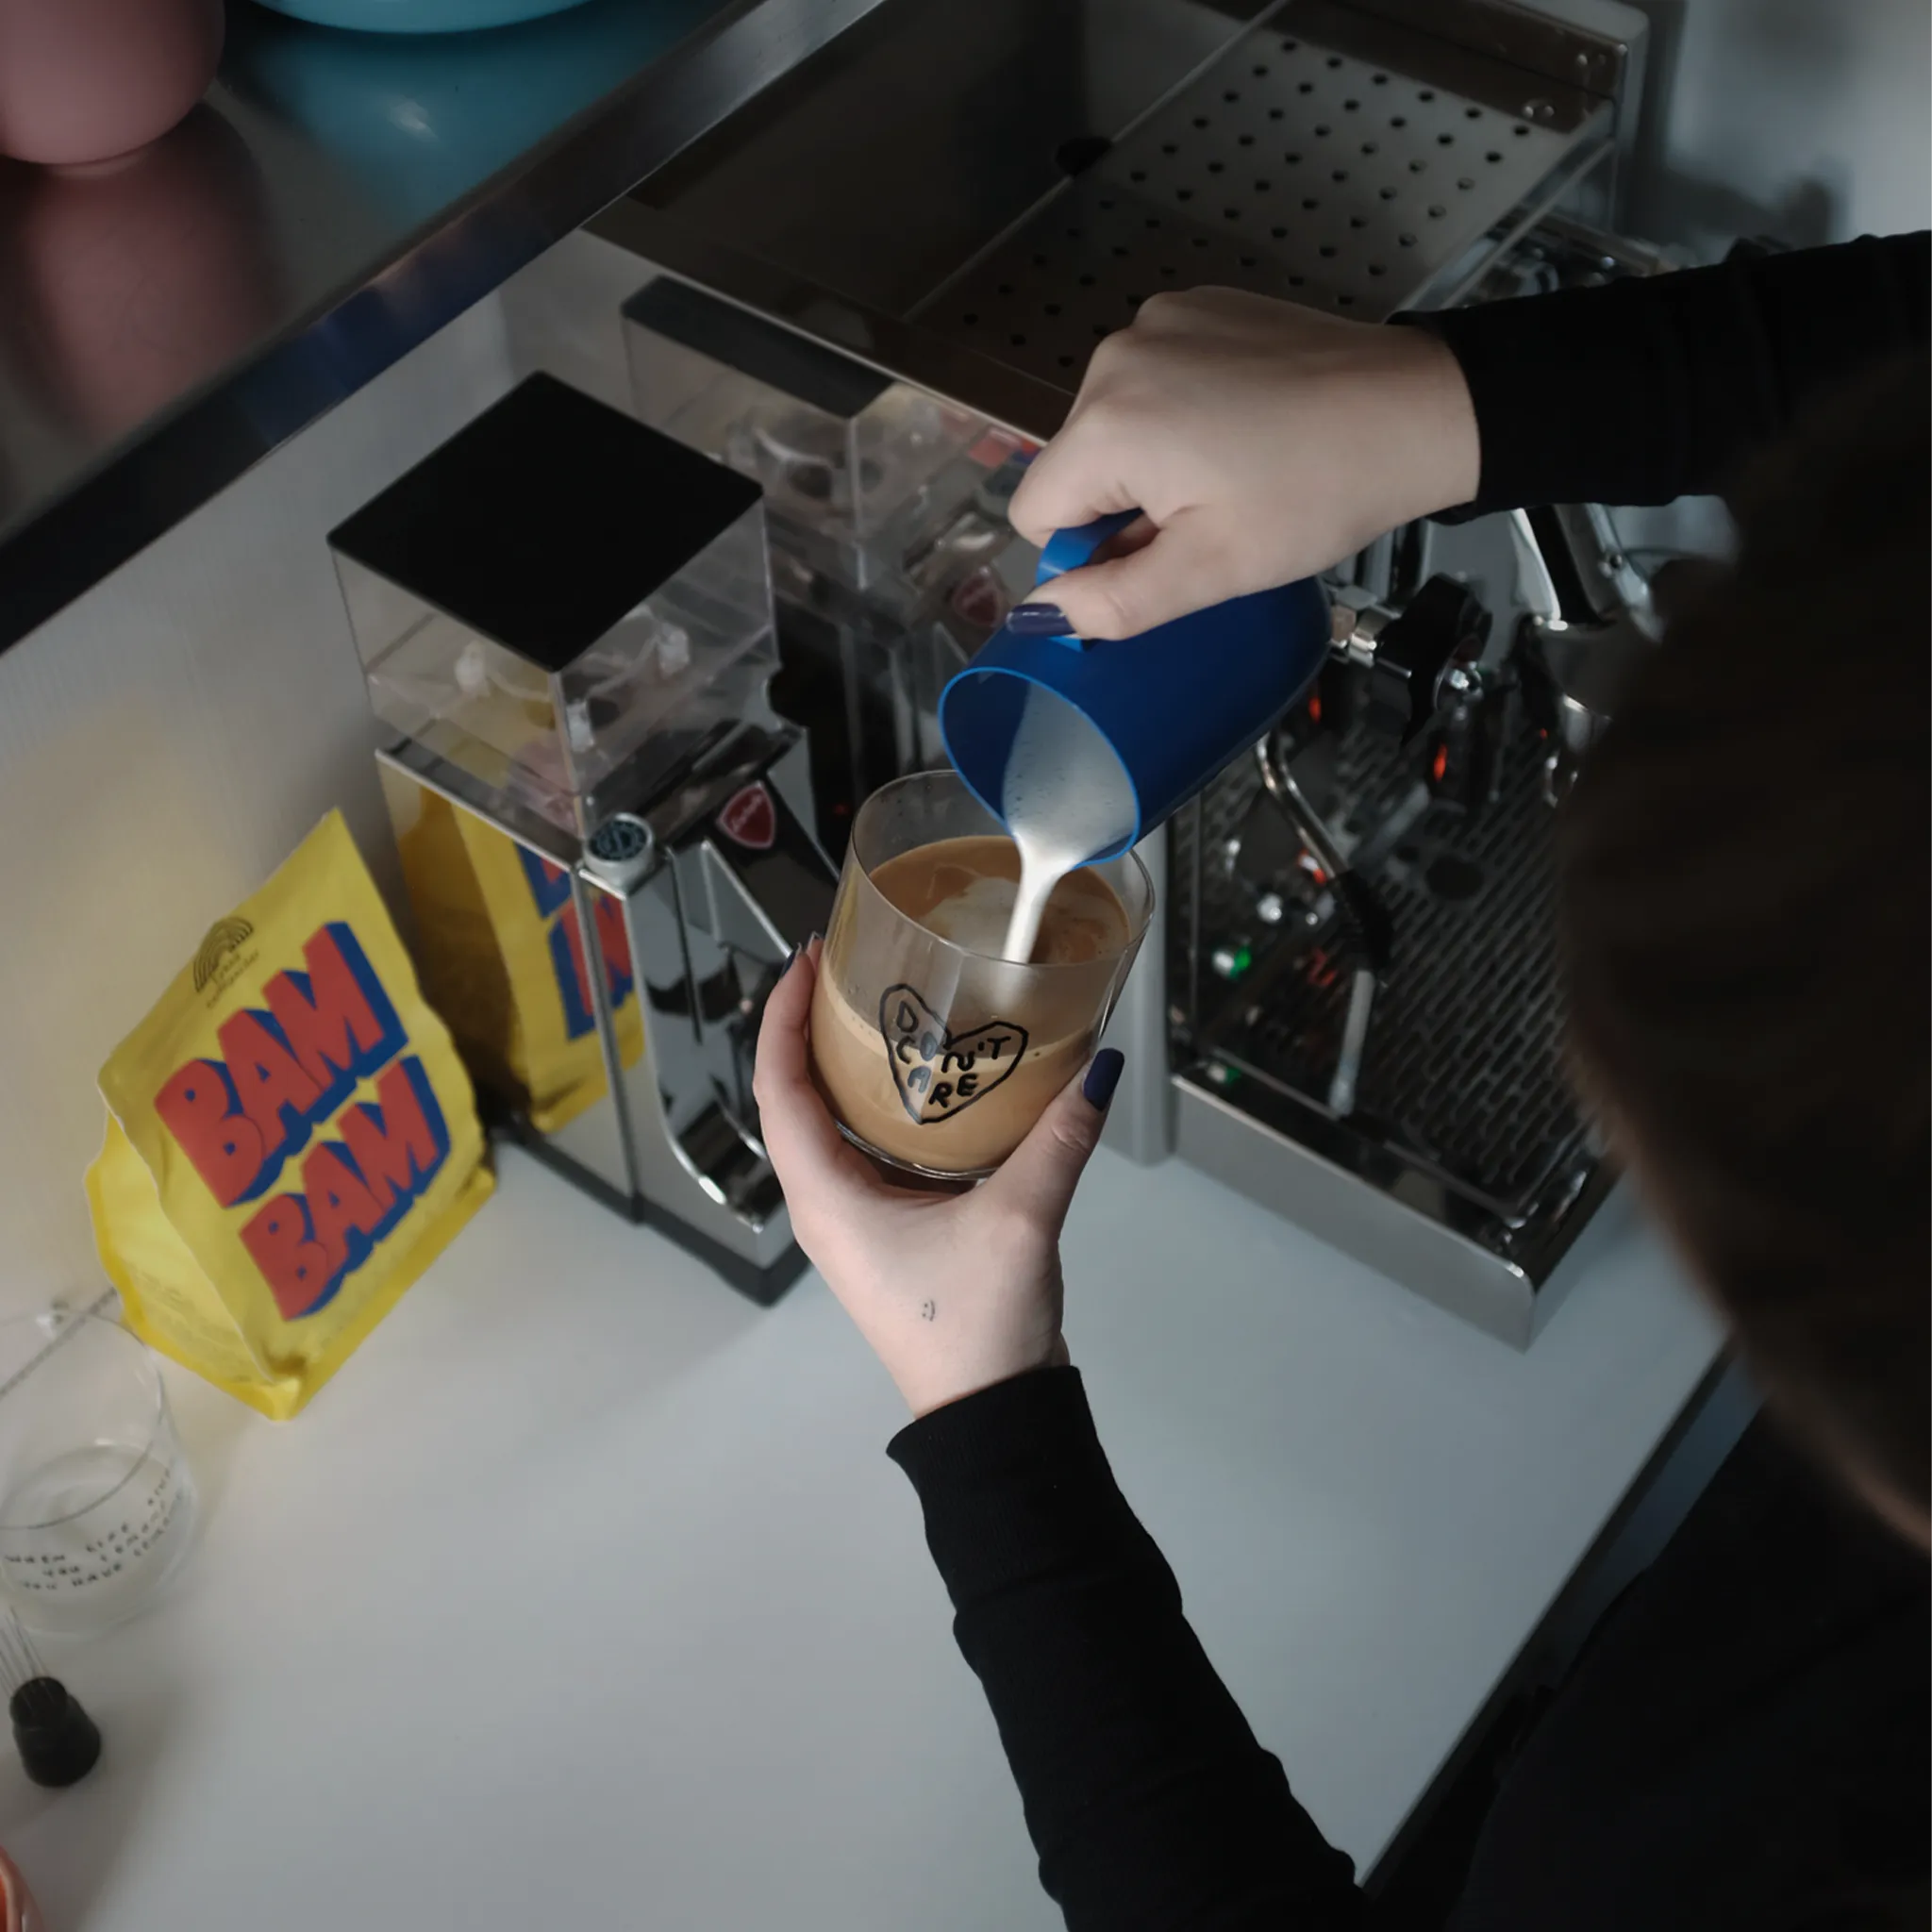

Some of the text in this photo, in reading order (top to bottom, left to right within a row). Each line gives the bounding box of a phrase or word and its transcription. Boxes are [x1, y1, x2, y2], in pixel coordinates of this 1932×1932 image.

[154, 921, 409, 1208] BAM
[239, 1054, 451, 1321] BAM
[896, 1036, 979, 1108] CARE
